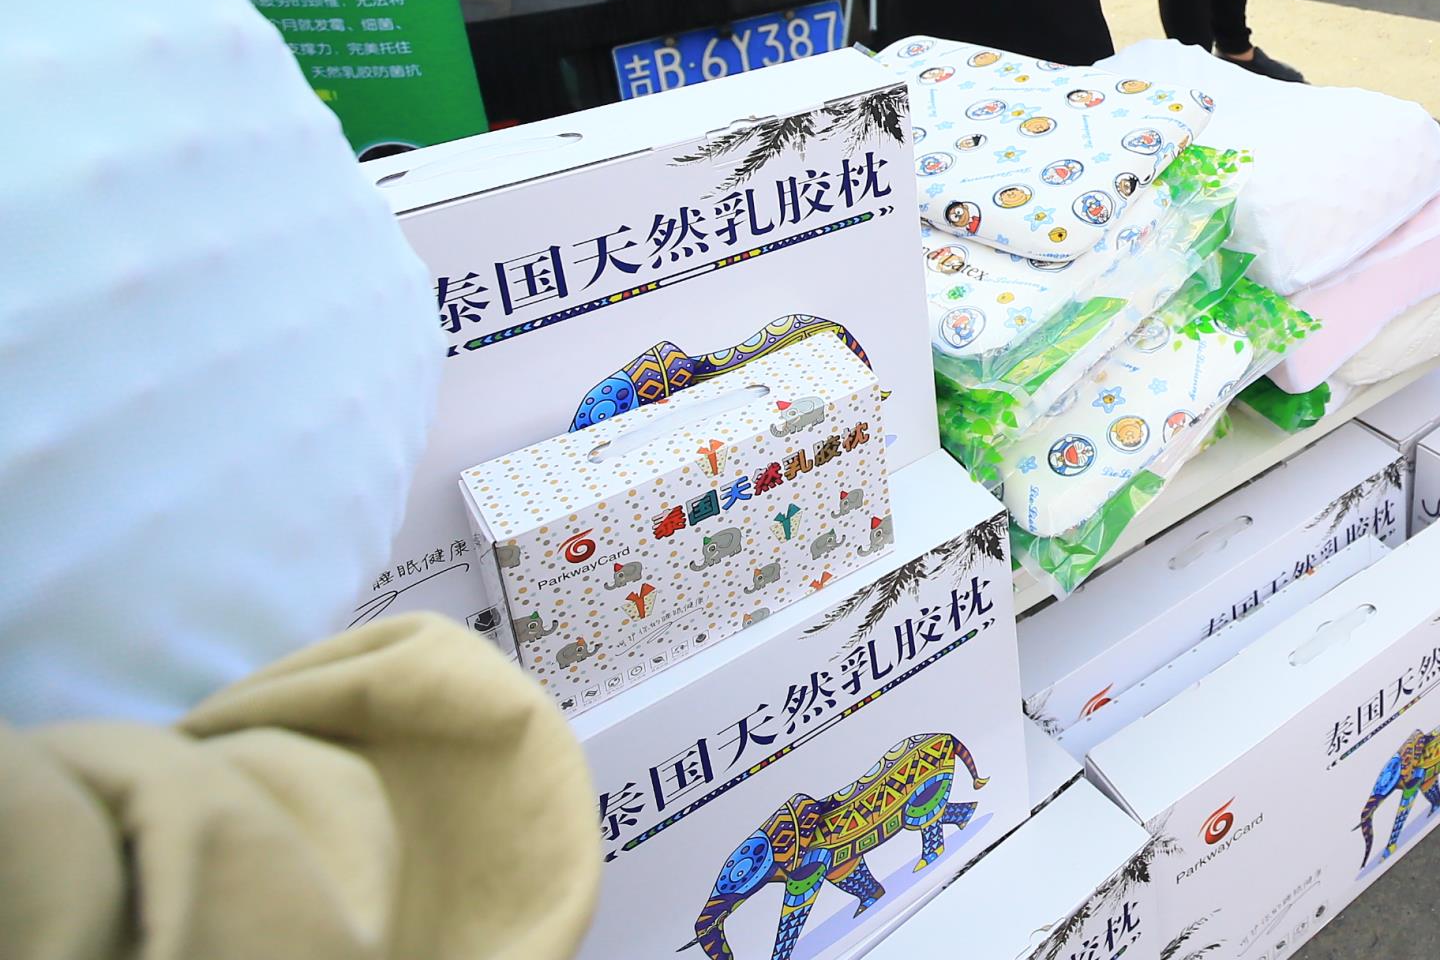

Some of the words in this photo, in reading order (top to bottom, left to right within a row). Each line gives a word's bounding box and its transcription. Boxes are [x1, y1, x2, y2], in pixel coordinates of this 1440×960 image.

[435, 151, 892, 333] 泰国天然乳胶枕
[651, 422, 870, 540] 泰国天然乳胶枕
[537, 546, 631, 590] ParkwayCard
[600, 576, 994, 840] 泰国天然乳胶枕
[1176, 812, 1264, 885] ParkwayCard
